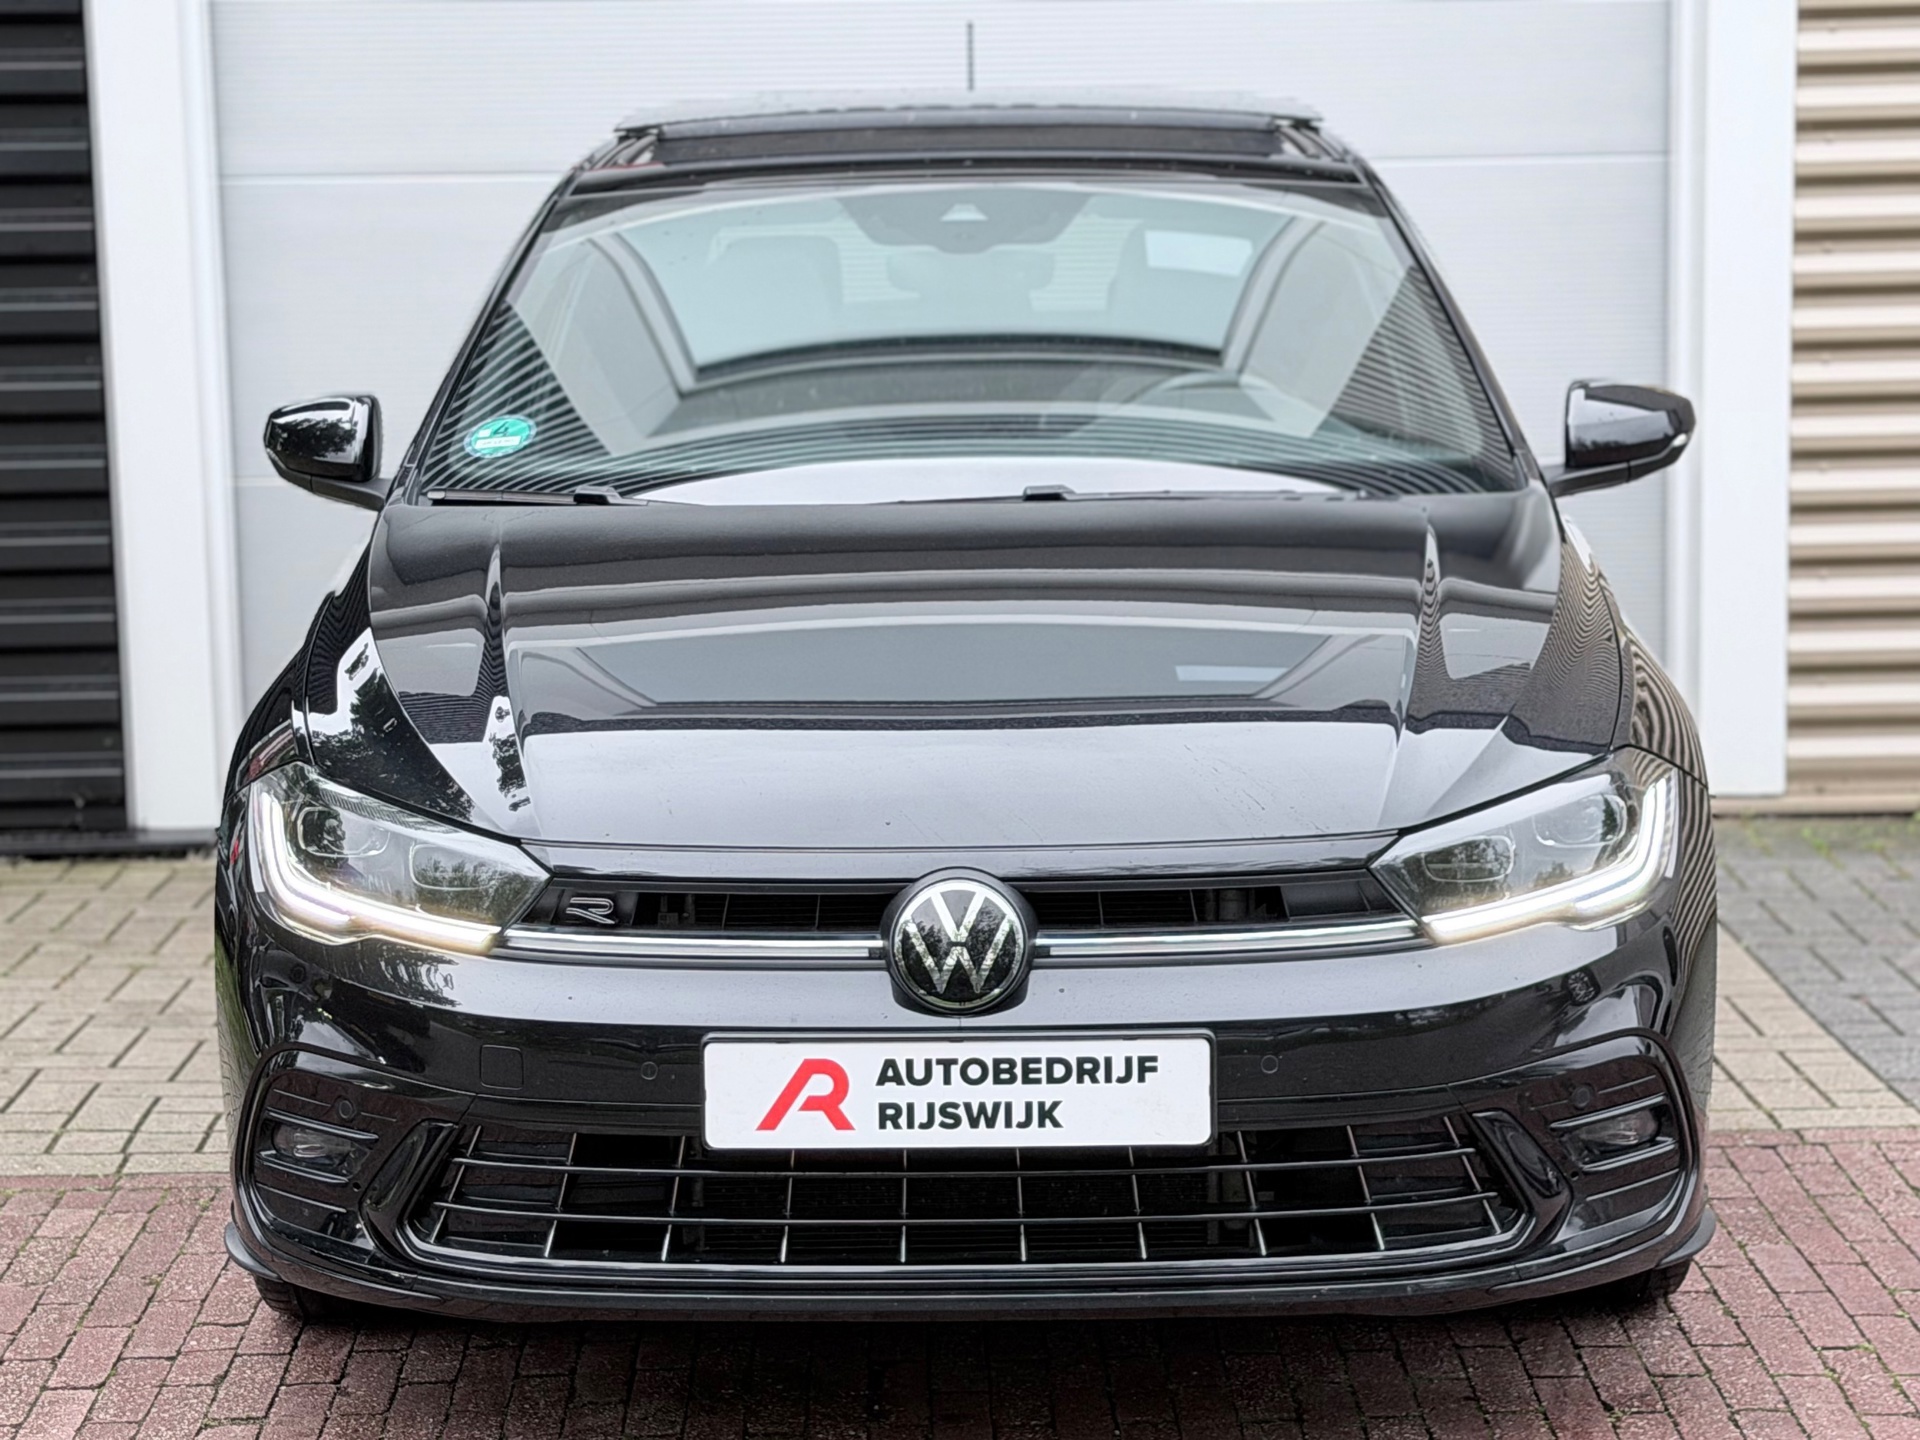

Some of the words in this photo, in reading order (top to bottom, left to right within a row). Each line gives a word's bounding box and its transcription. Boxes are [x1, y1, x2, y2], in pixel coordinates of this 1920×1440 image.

[493, 421, 509, 436] 4
[565, 896, 616, 925] R
[901, 885, 1013, 994] VW
[875, 1055, 1159, 1087] AUTOBEDRIJF
[878, 1100, 1064, 1131] RIJSWIJK
